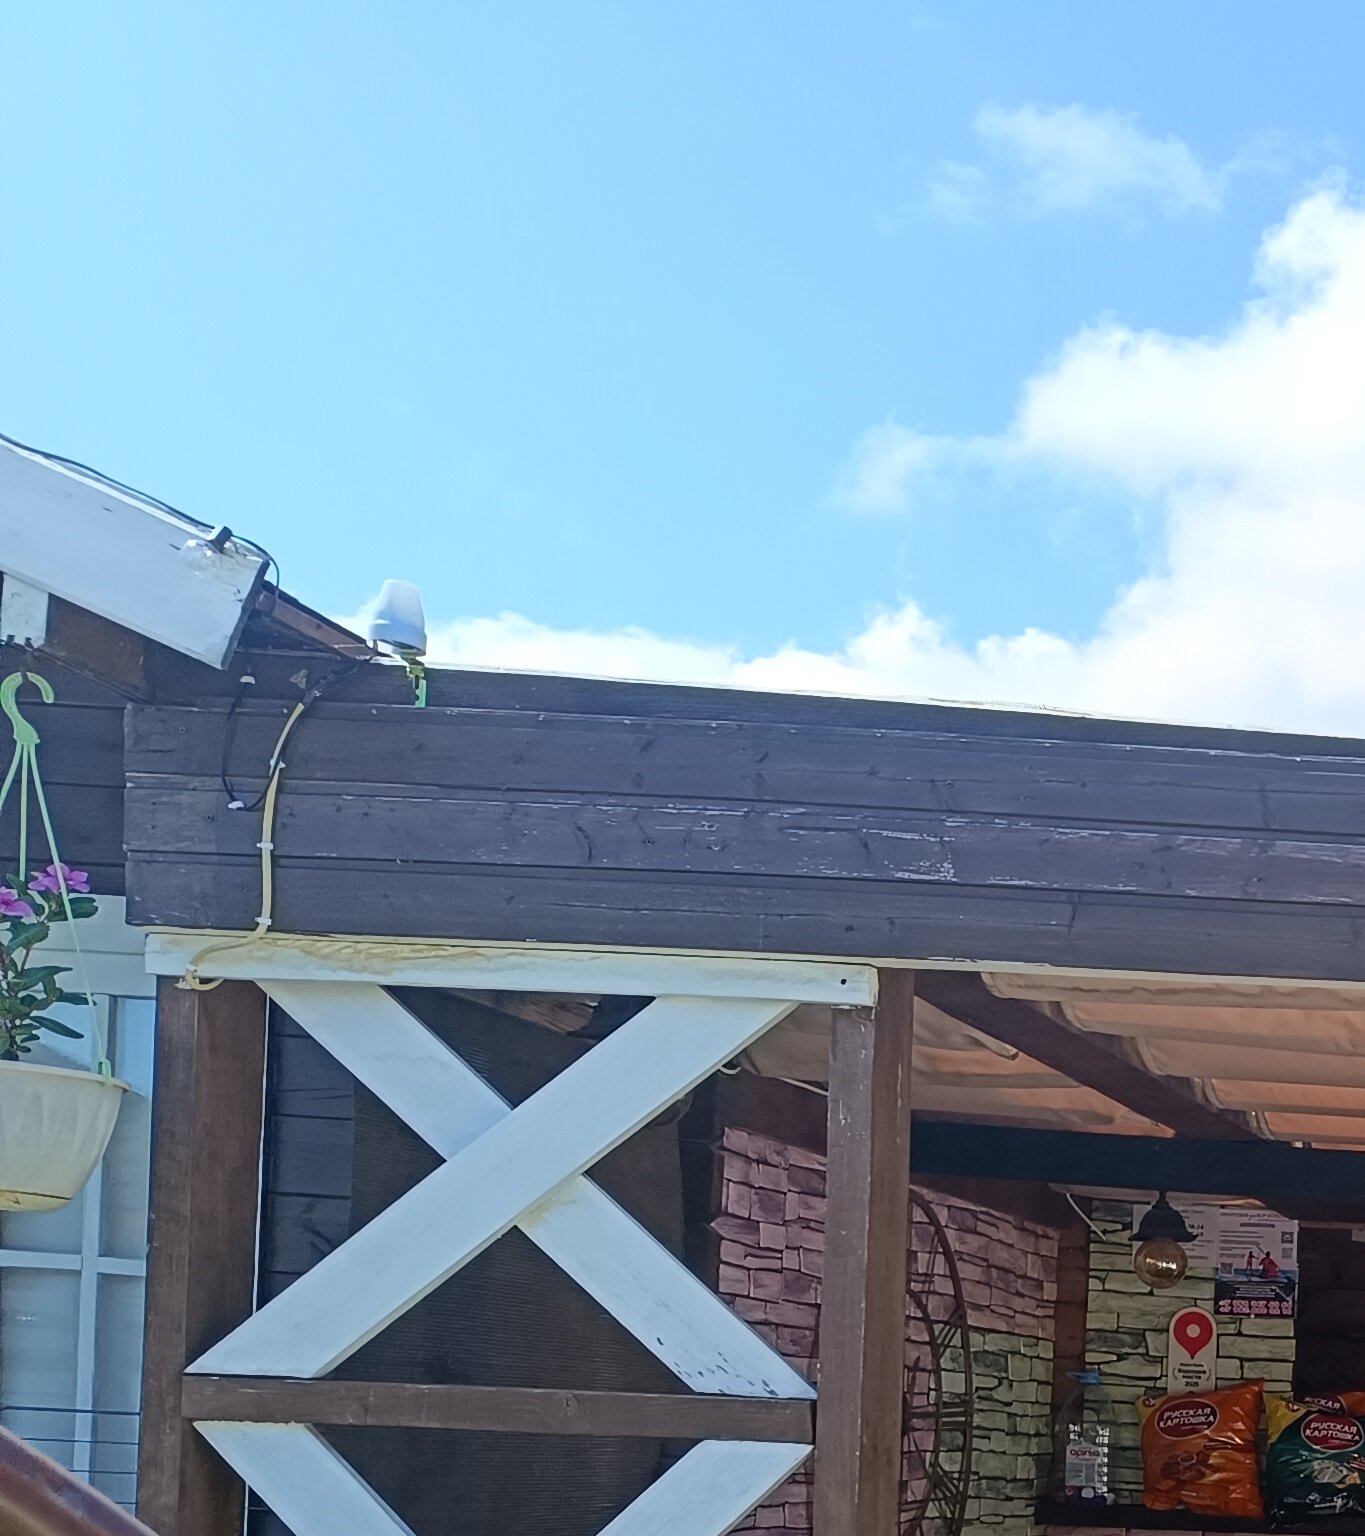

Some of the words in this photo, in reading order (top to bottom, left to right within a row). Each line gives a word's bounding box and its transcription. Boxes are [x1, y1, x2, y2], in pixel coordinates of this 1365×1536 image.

[1163, 1406, 1211, 1420] РУССКАЯ
[1158, 1414, 1215, 1429] КАРТОШКА
[1310, 1421, 1358, 1434] РУССКАЯ
[1304, 1428, 1361, 1441] КАРТОШКА
